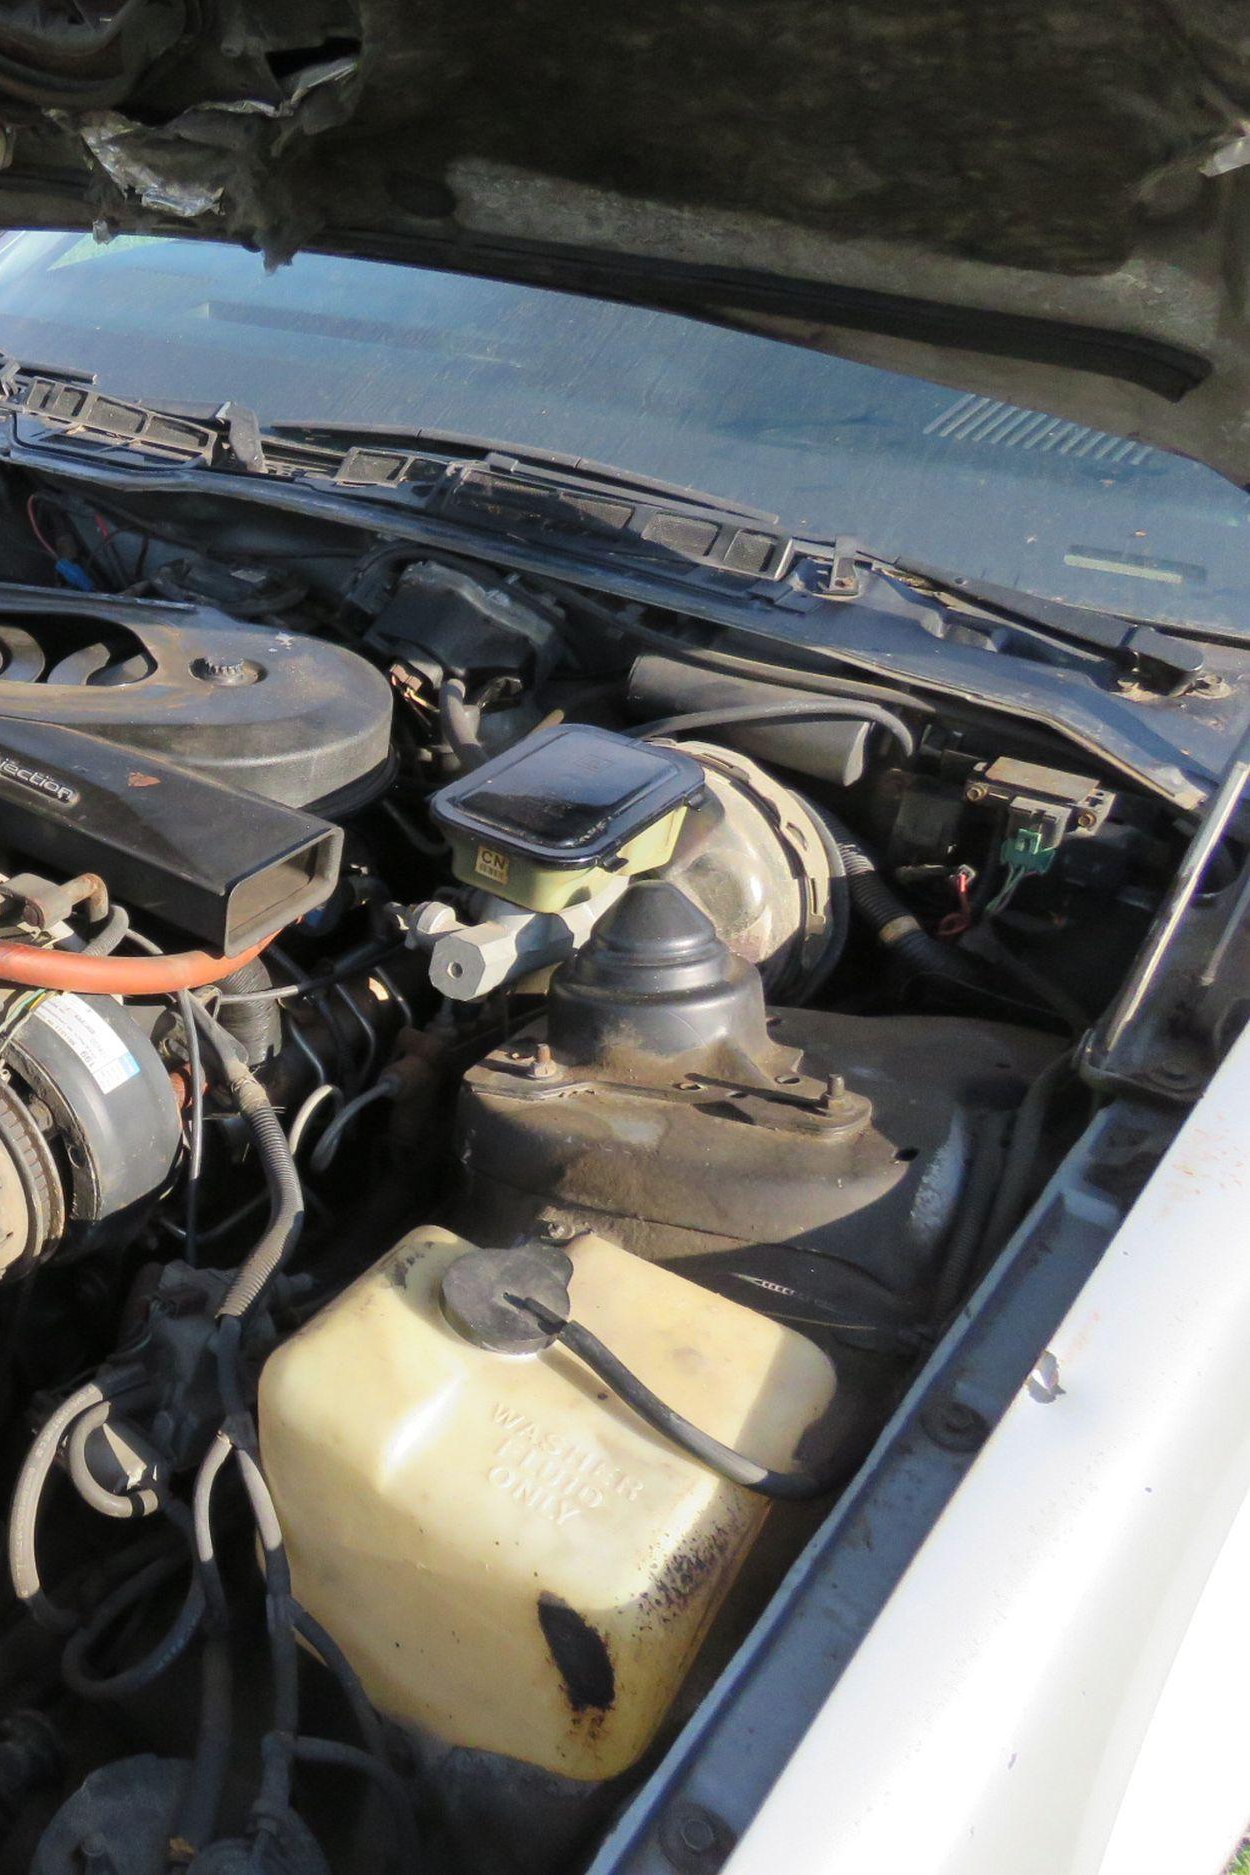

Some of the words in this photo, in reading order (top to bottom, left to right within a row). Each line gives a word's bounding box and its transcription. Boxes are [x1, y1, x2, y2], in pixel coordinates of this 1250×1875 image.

[481, 850, 506, 869] CN
[492, 1402, 644, 1502] WASHER
[487, 1466, 581, 1525] ONLY
